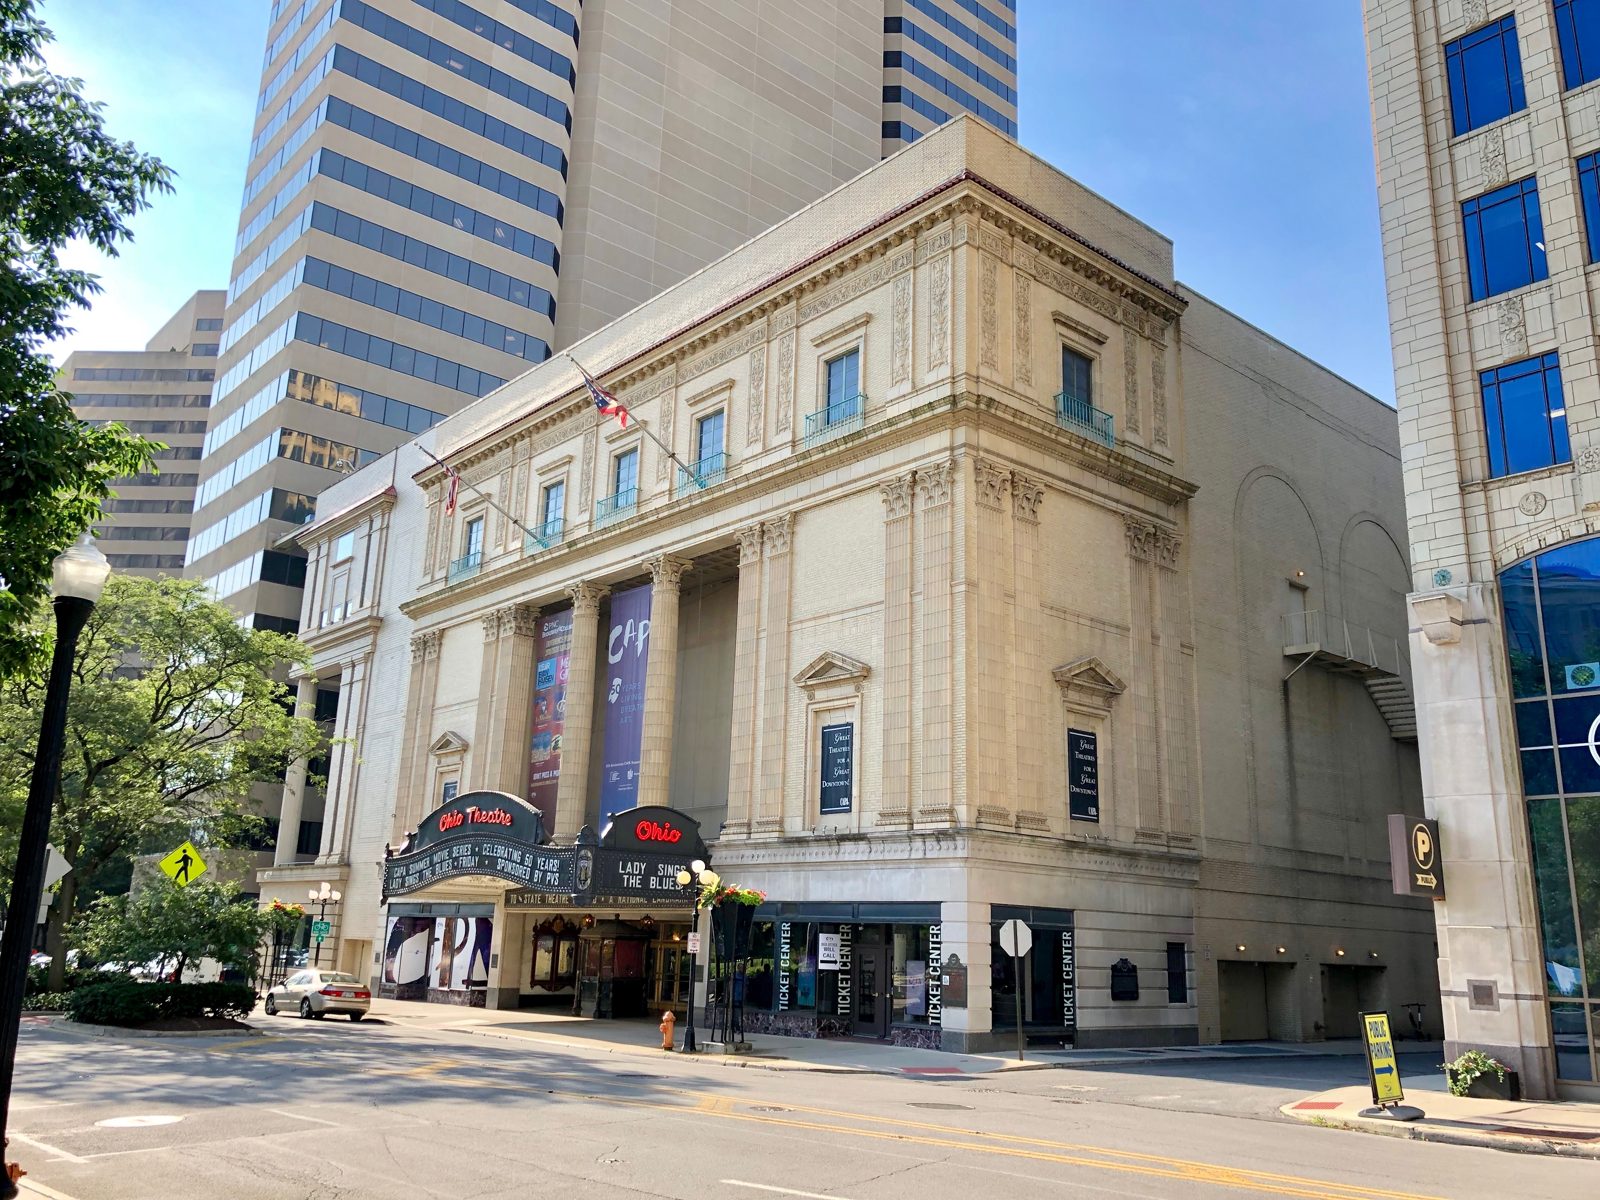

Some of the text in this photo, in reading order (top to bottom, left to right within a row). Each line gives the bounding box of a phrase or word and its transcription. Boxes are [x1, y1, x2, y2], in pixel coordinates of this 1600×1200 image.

[439, 806, 513, 832] Ohio Theatre
[635, 819, 682, 843] Ohio
[1416, 831, 1430, 861] P
[389, 856, 560, 889] LADY SINGS THE BLUES FRIDAY SPONSORED BY PVS
[393, 866, 406, 878] CAPA
[409, 857, 430, 874] SUMMER
[433, 848, 450, 863] MOVIE
[452, 844, 472, 858] SERIES
[482, 844, 522, 863] CELEBRATING
[537, 857, 560, 872] YEARS!
[619, 861, 647, 875] LADY
[623, 875, 642, 888] THE
[524, 894, 541, 904] STATE
[545, 893, 569, 904] THEATRE
[779, 922, 791, 1011] TICKET CENTER
[838, 924, 852, 1015] TICKET CENTER
[928, 925, 941, 1026] TICKET CENTER
[1062, 931, 1075, 1028] TICKET CENTER
[1368, 1020, 1387, 1039] PUBLIC
[1369, 1041, 1393, 1060] PARKING
